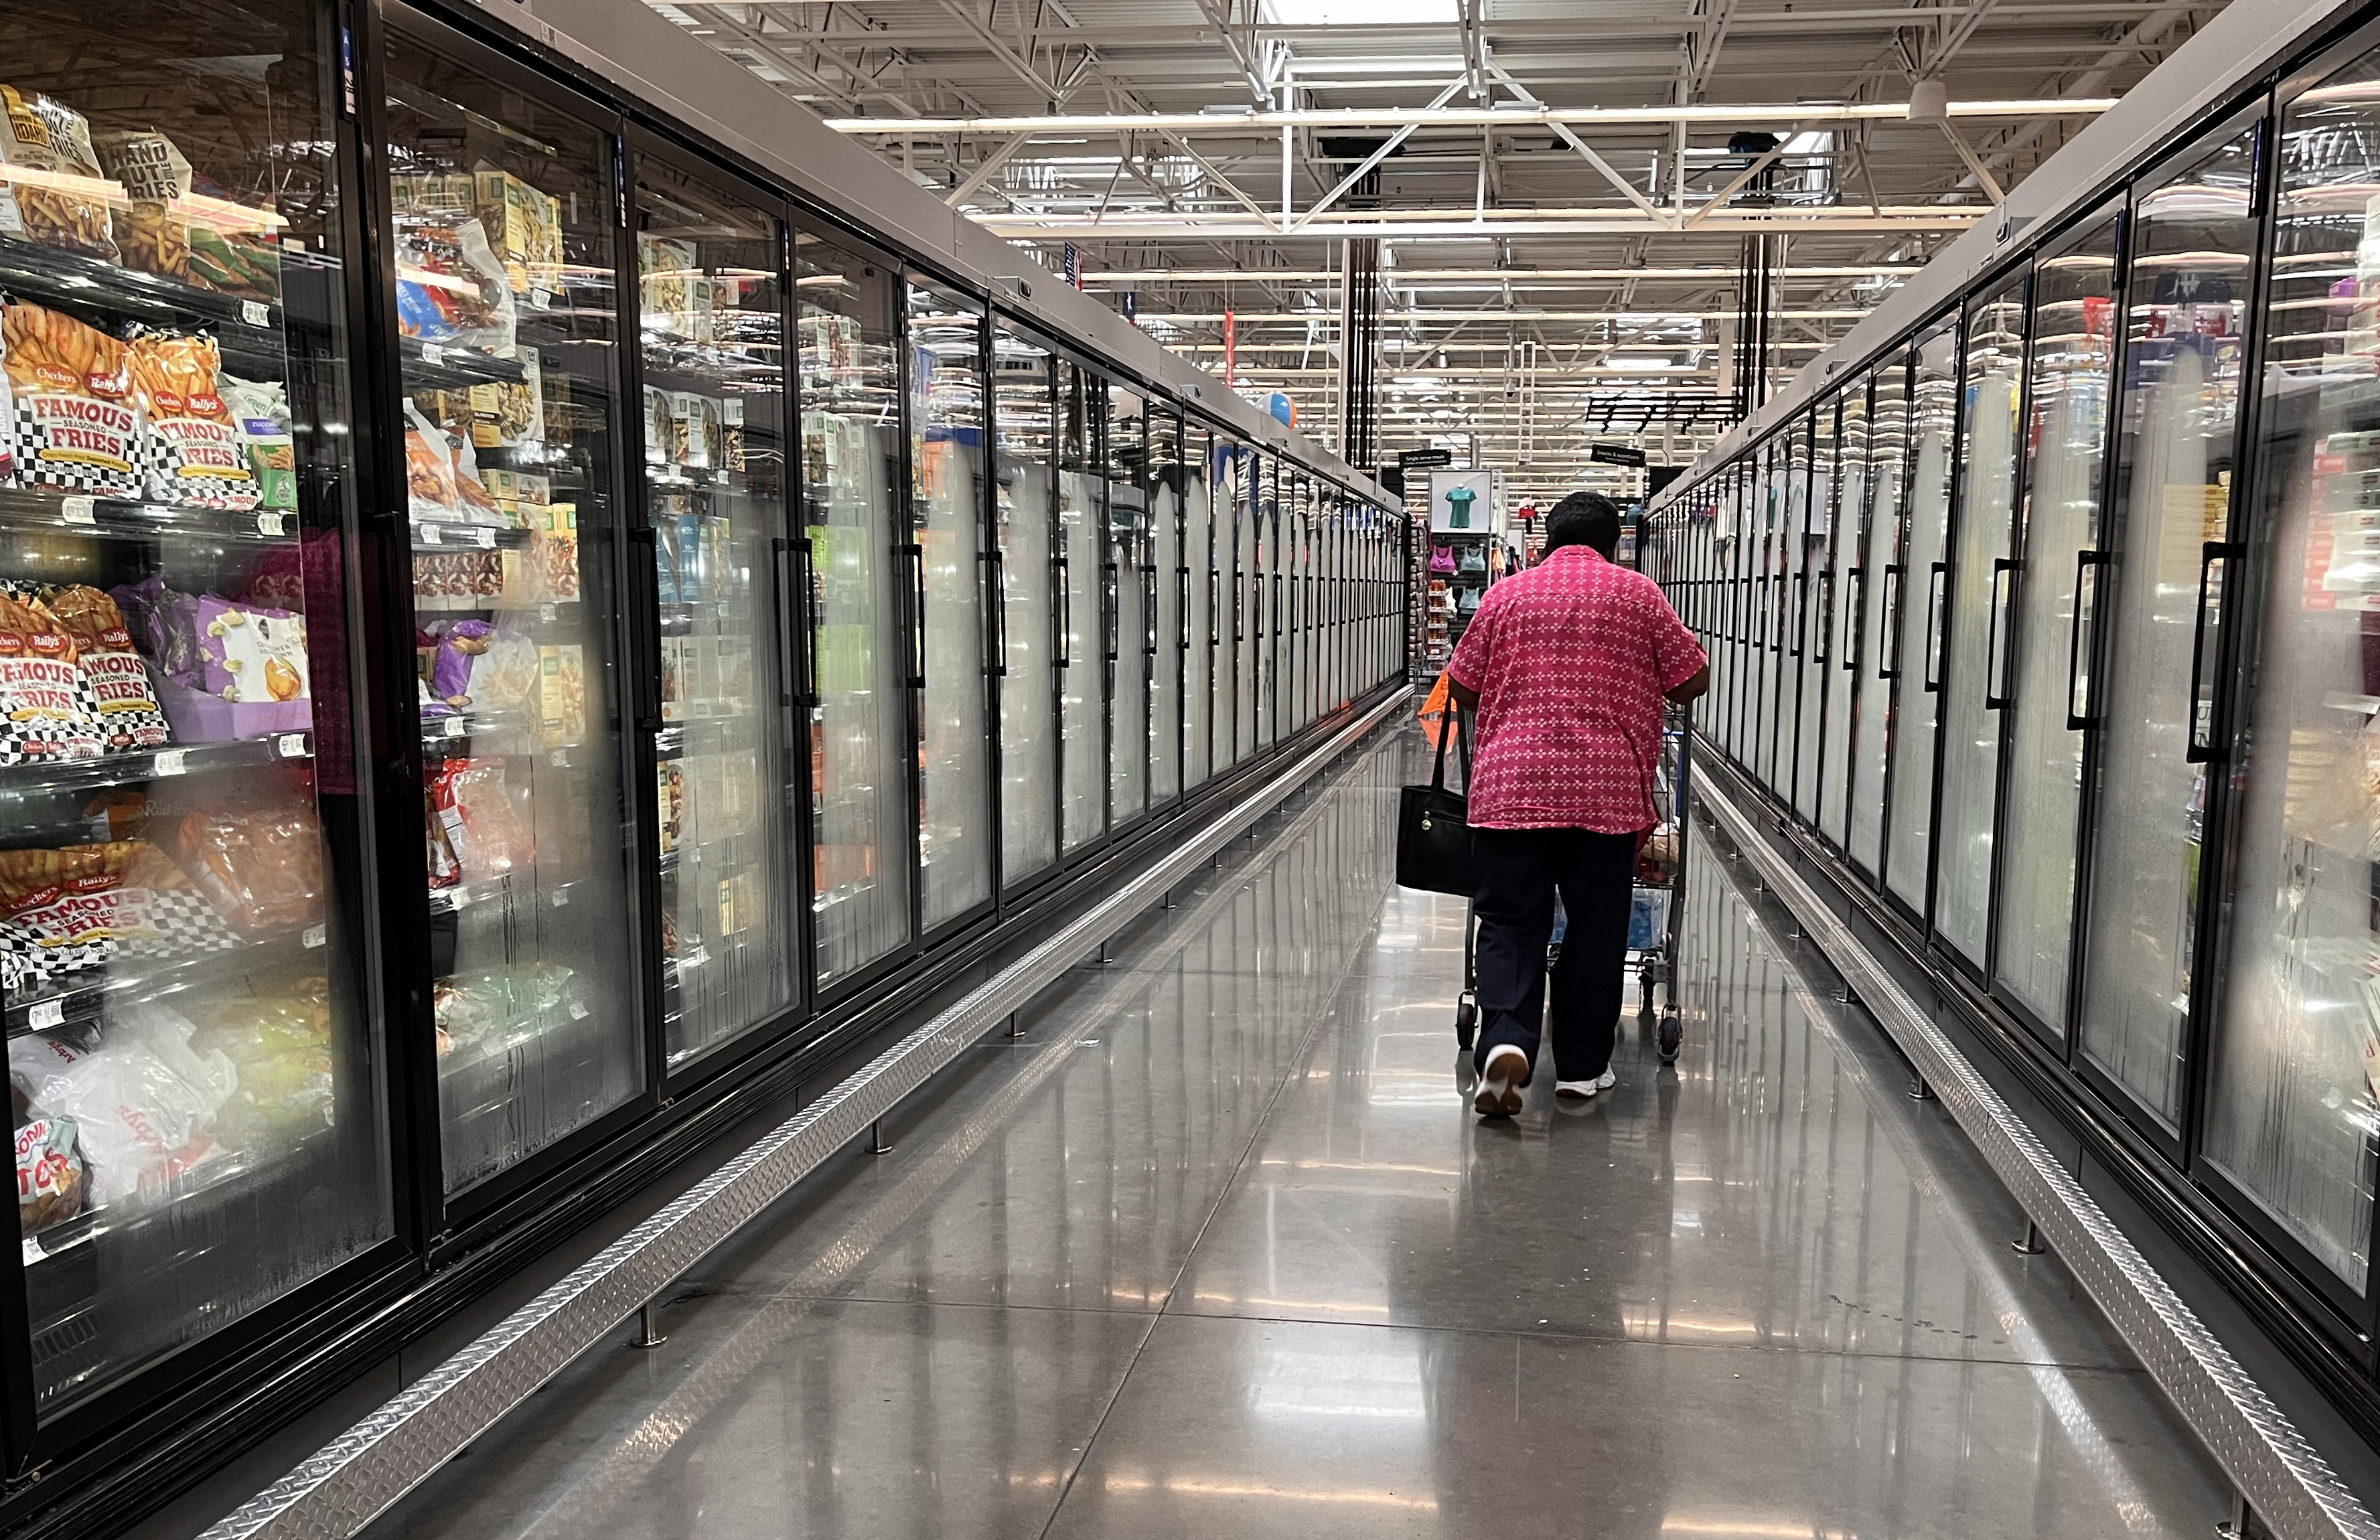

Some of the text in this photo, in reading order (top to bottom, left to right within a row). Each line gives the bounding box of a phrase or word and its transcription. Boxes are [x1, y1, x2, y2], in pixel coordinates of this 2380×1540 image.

[48, 133, 85, 163] FRIES
[107, 141, 169, 169] HAND
[127, 181, 179, 199] RIES
[36, 368, 77, 384] Checkers
[190, 398, 218, 411] Rally's
[243, 394, 267, 411] Green
[33, 398, 133, 433] FAMOUS
[63, 419, 107, 434] SEASONED
[50, 427, 121, 456] FRIES
[185, 440, 220, 449] SEASONED
[32, 635, 60, 649] Rally's
[103, 631, 129, 643] Rally's
[90, 674, 131, 684] SEASONED
[92, 682, 145, 702] RIES
[135, 727, 165, 738] FAMOUS
[78, 874, 118, 887] Rally's
[10, 886, 58, 911] Checkers
[14, 890, 147, 929] FAMOUS
[57, 909, 115, 927] SEASONED
[45, 1040, 76, 1064] Arby's
